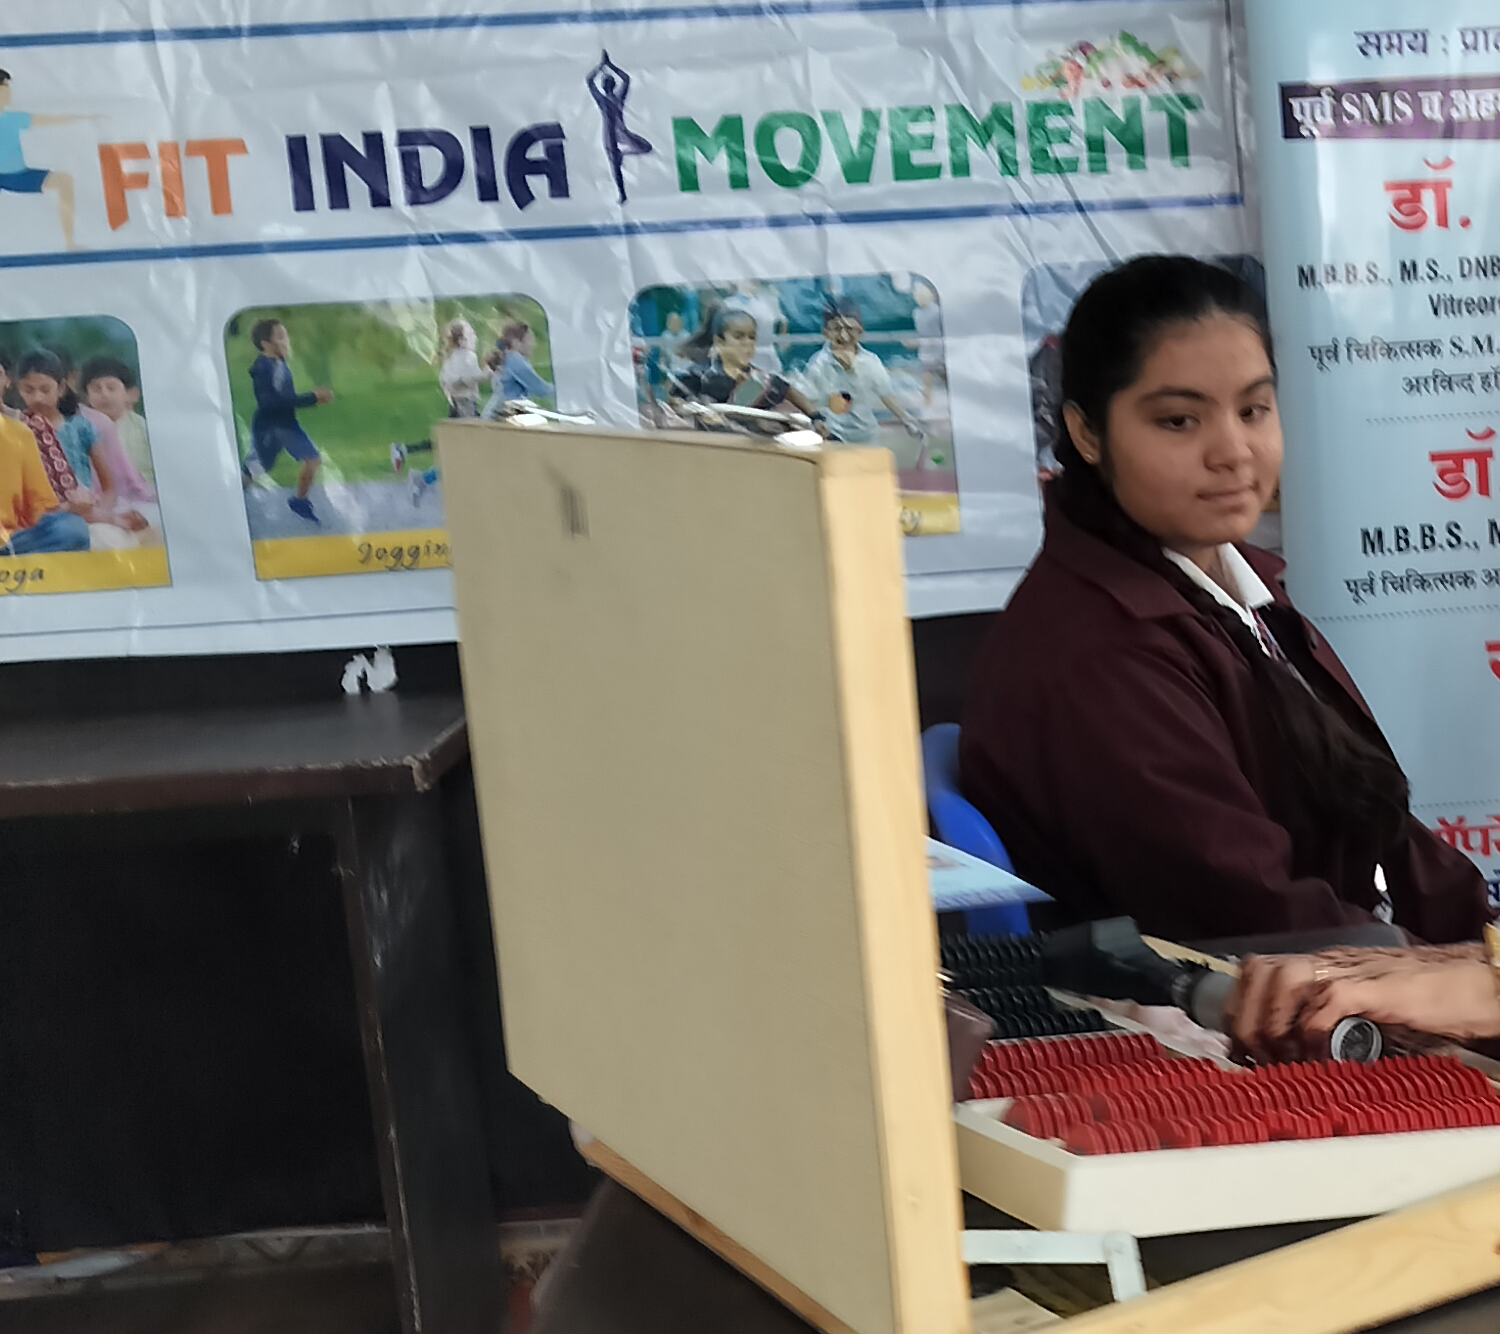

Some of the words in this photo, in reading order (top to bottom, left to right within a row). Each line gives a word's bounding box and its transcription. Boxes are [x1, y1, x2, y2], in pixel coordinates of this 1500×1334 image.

[1354, 27, 1429, 59] समय
[1289, 86, 1337, 140] पूर्व
[1341, 90, 1414, 126] SMS
[97, 138, 249, 231] FIT
[284, 122, 571, 212] INDIA
[670, 91, 1204, 193] MOVEMENT
[1384, 155, 1472, 232] डॉ.
[1399, 257, 1454, 286] M.S.,
[1306, 336, 1342, 374] पूर्व
[1344, 334, 1445, 366] चिकित्सक
[1402, 367, 1477, 398] अरविन्द
[357, 540, 453, 573] Joggin
[1360, 519, 1481, 560] M.B.B.S.,
[1343, 568, 1377, 607] पूर्व
[1379, 567, 1479, 597] चिकित्सक
